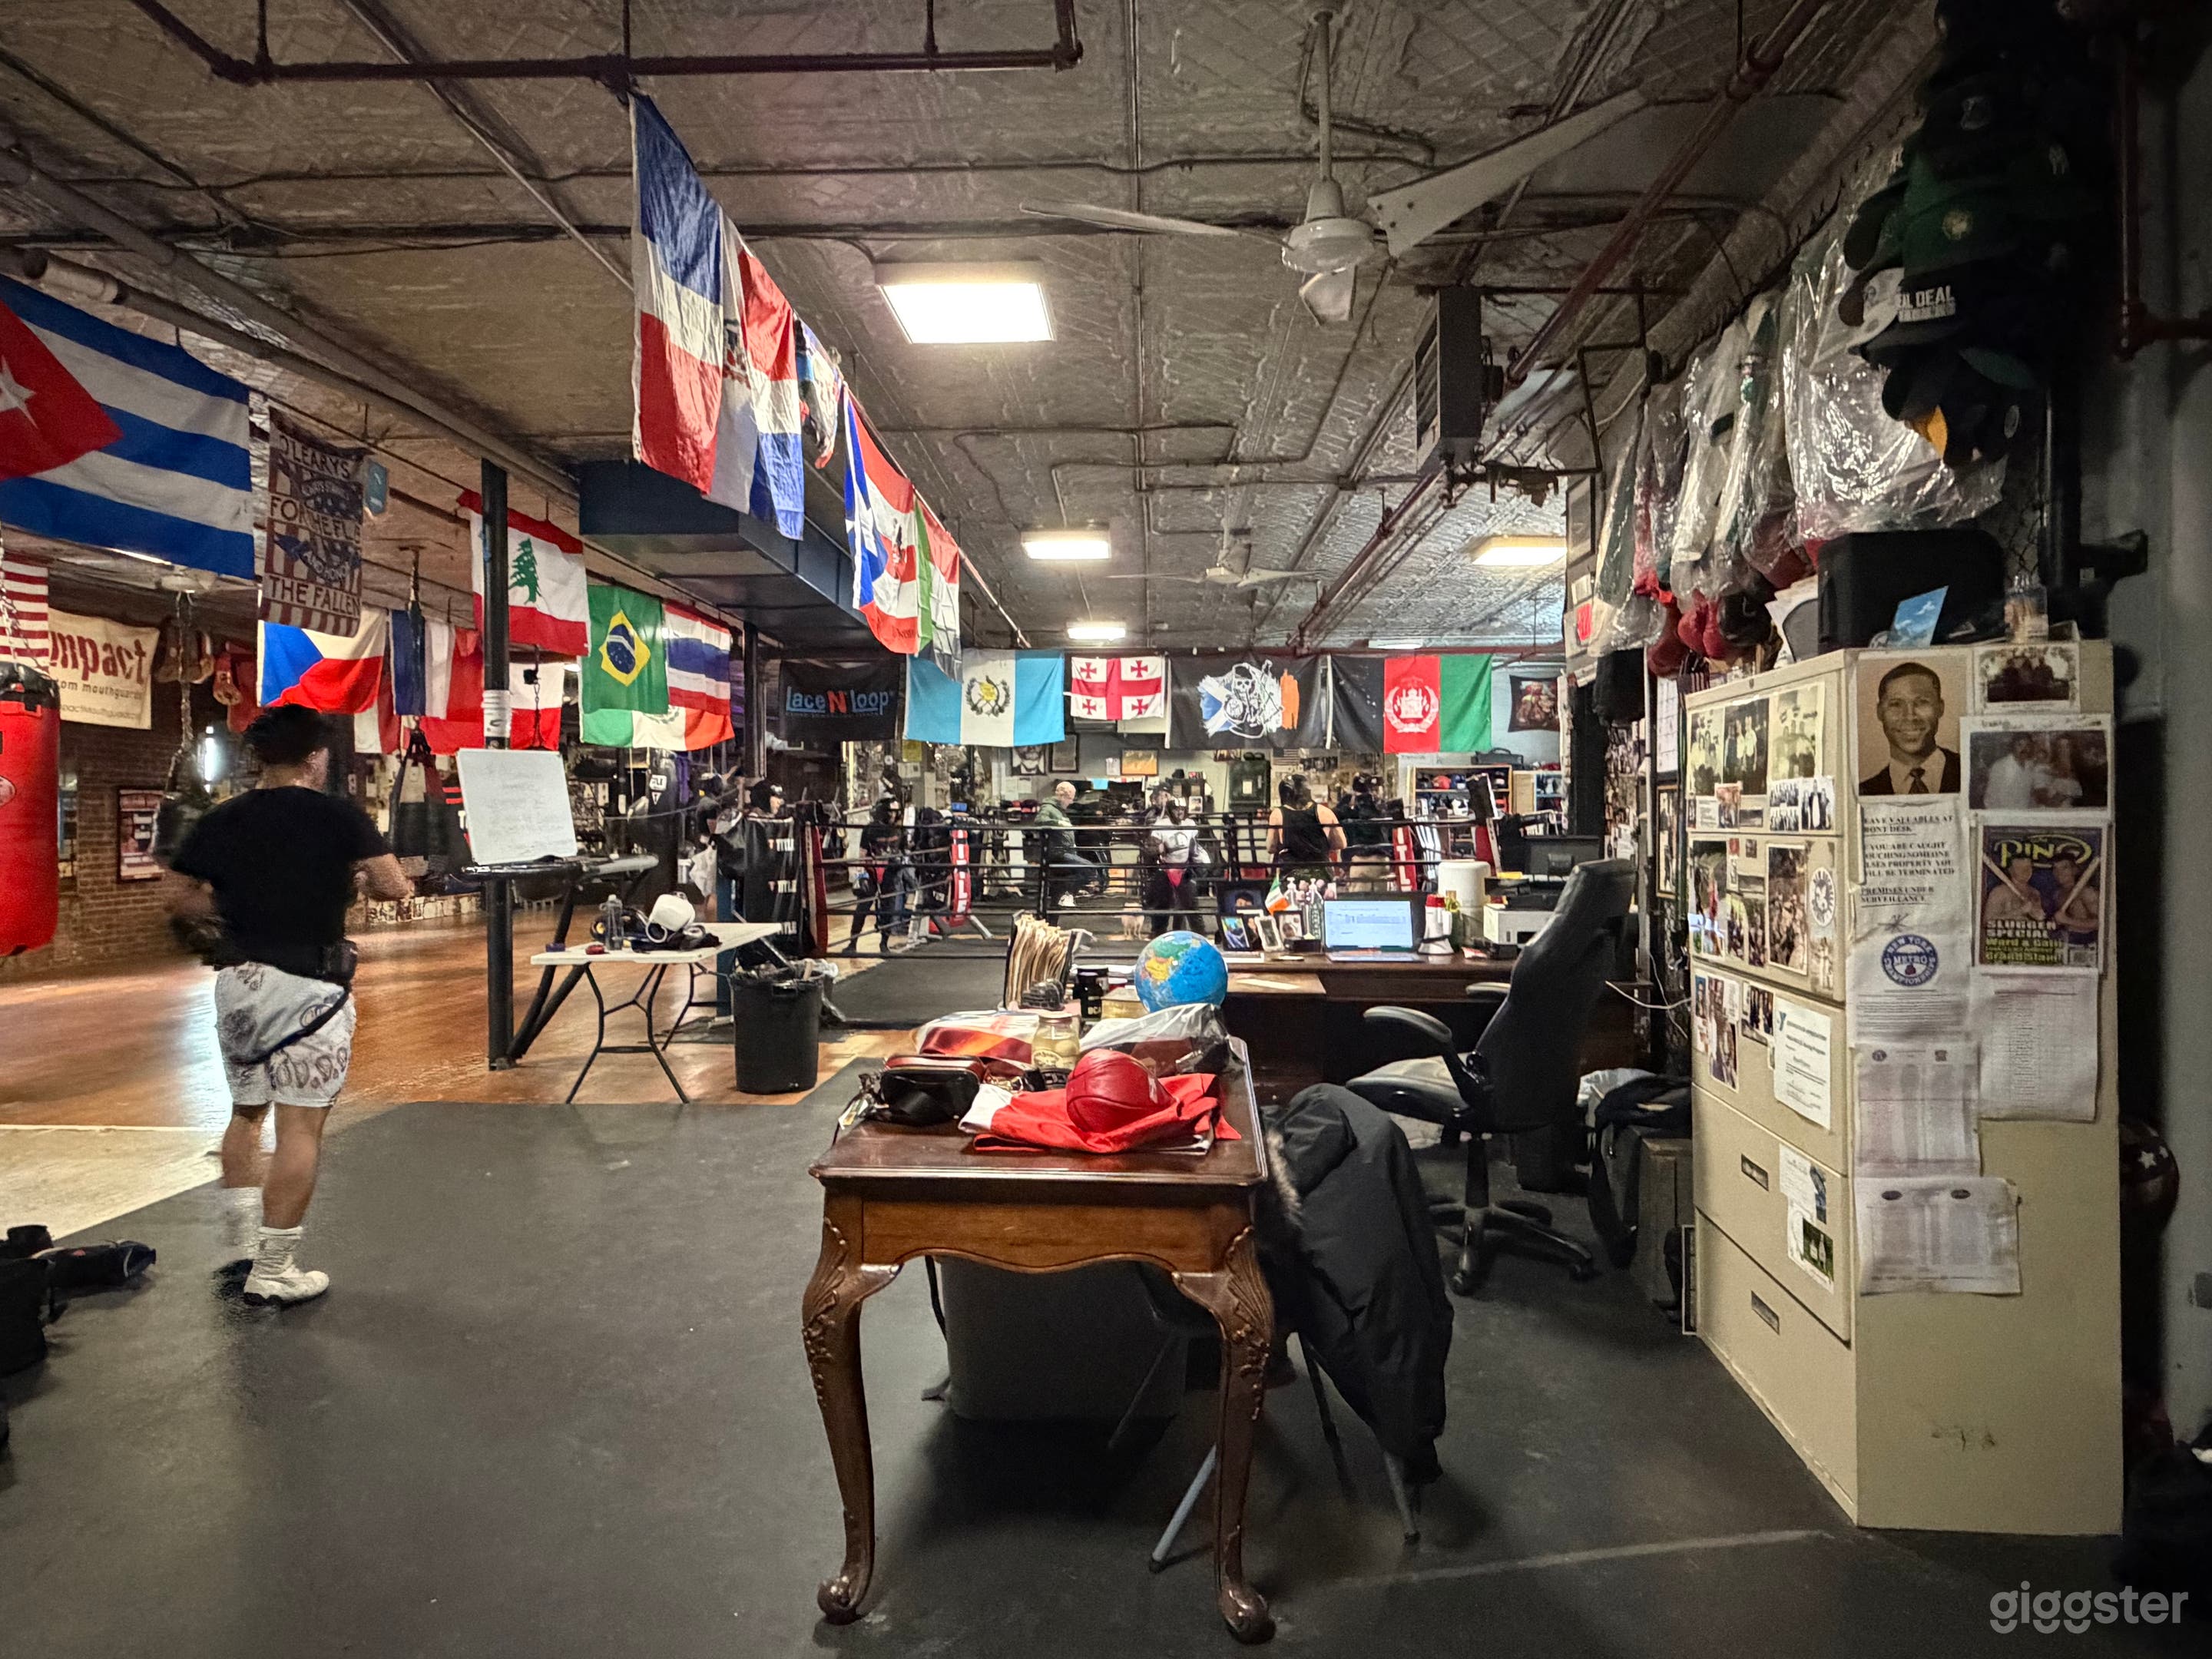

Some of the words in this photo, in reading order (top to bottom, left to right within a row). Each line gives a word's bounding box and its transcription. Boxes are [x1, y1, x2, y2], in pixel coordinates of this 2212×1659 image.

[1916, 284, 1955, 307] DEAL
[269, 575, 309, 604] THE
[313, 586, 361, 620] FALLEN
[49, 631, 147, 684] mpact
[827, 690, 847, 714] N
[1892, 842, 1907, 850] ARE
[1909, 840, 1946, 849] CAUGHT
[1906, 850, 1950, 859] SOMEONE
[1888, 859, 1933, 868] PROPERTY
[1860, 886, 1904, 896] PREMISES
[1860, 896, 1926, 904] SURVEILLANCE
[1892, 955, 1929, 965] METRO
